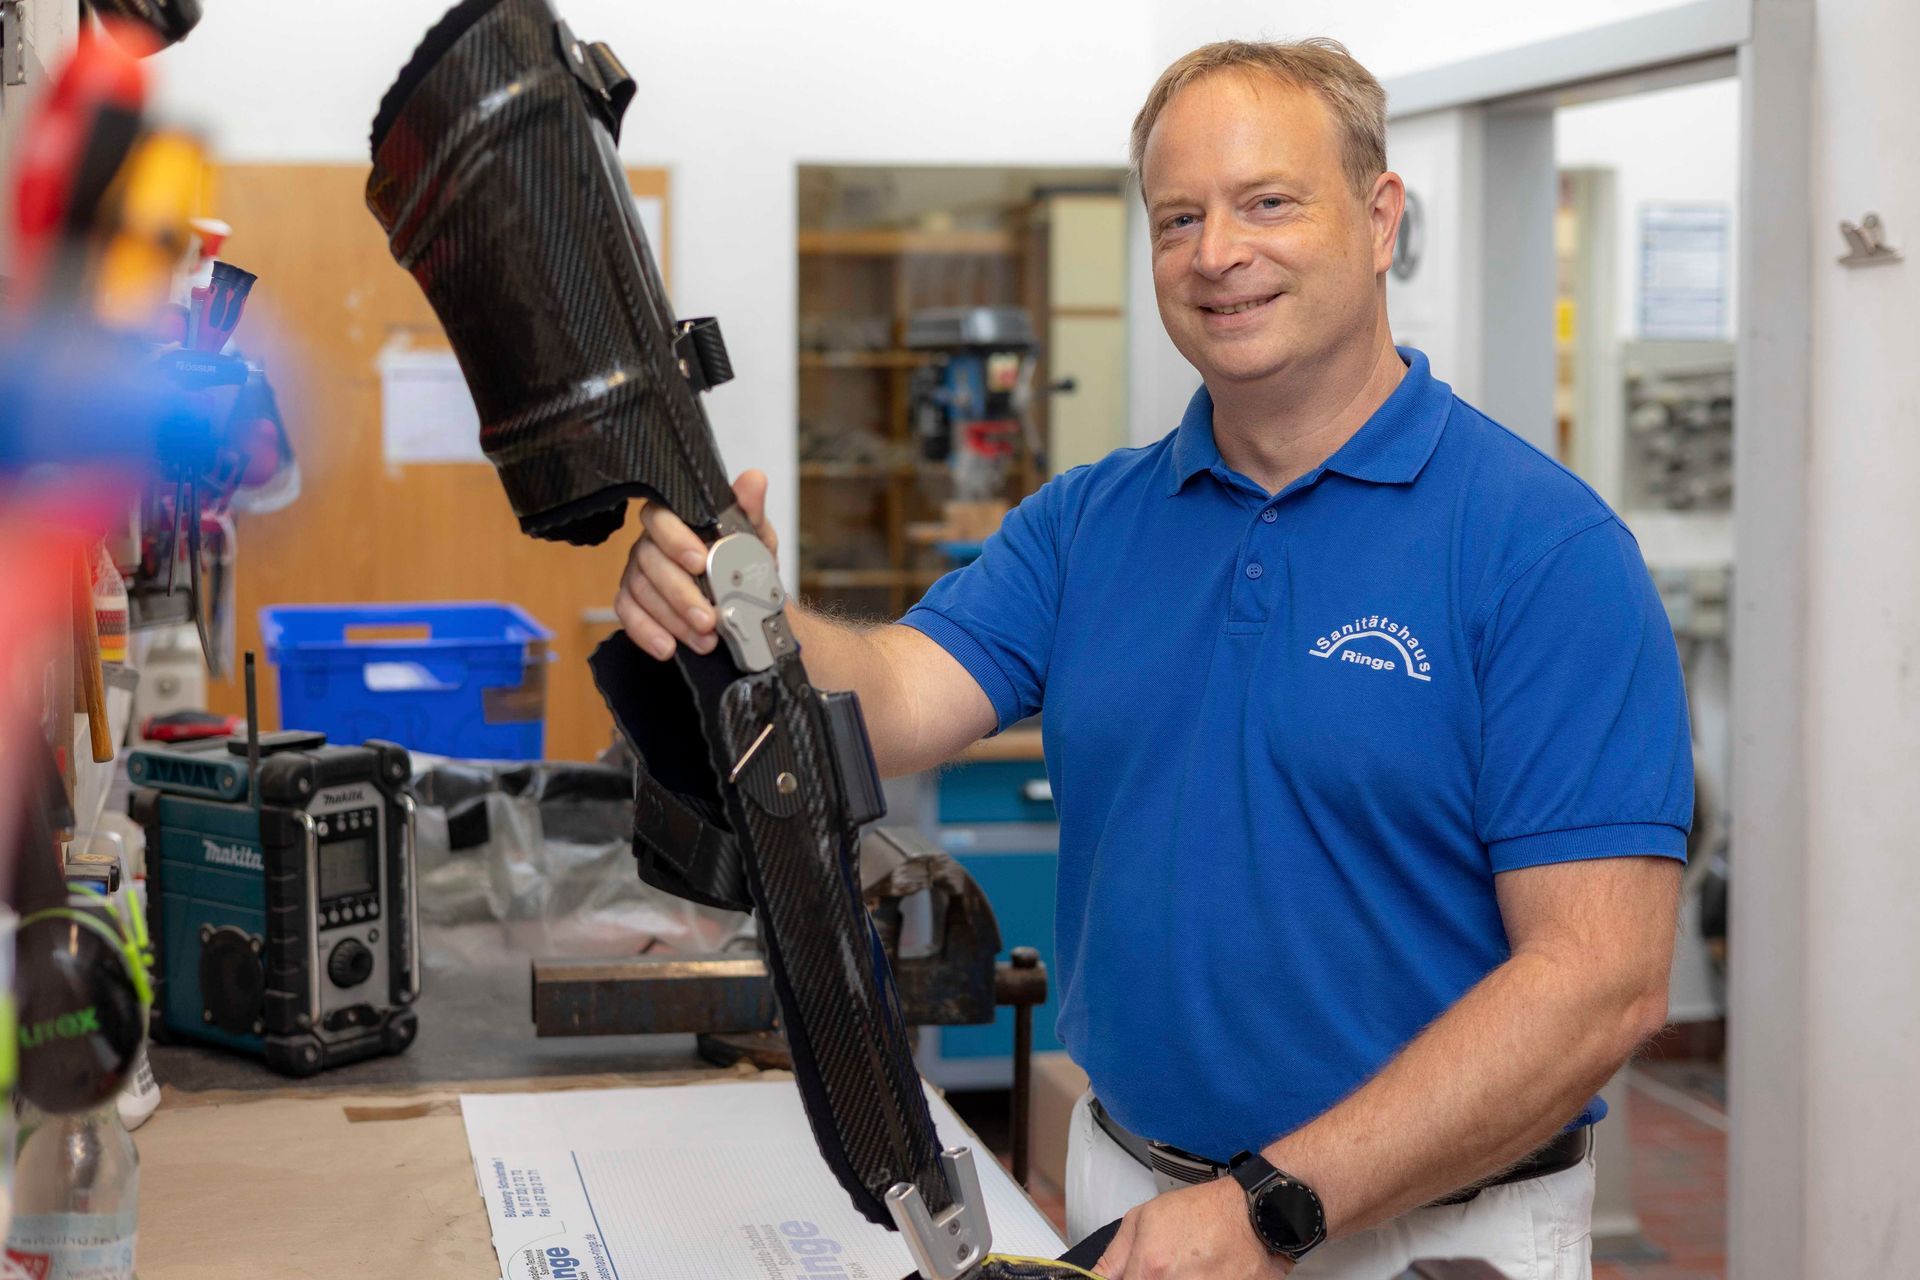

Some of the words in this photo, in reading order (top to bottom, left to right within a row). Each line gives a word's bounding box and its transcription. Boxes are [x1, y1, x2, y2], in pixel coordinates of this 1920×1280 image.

[1316, 615, 1431, 672] Sanitätshaus
[1341, 650, 1396, 670] Ringe
[546, 1247, 580, 1280] nge
[779, 1220, 849, 1280] inge
